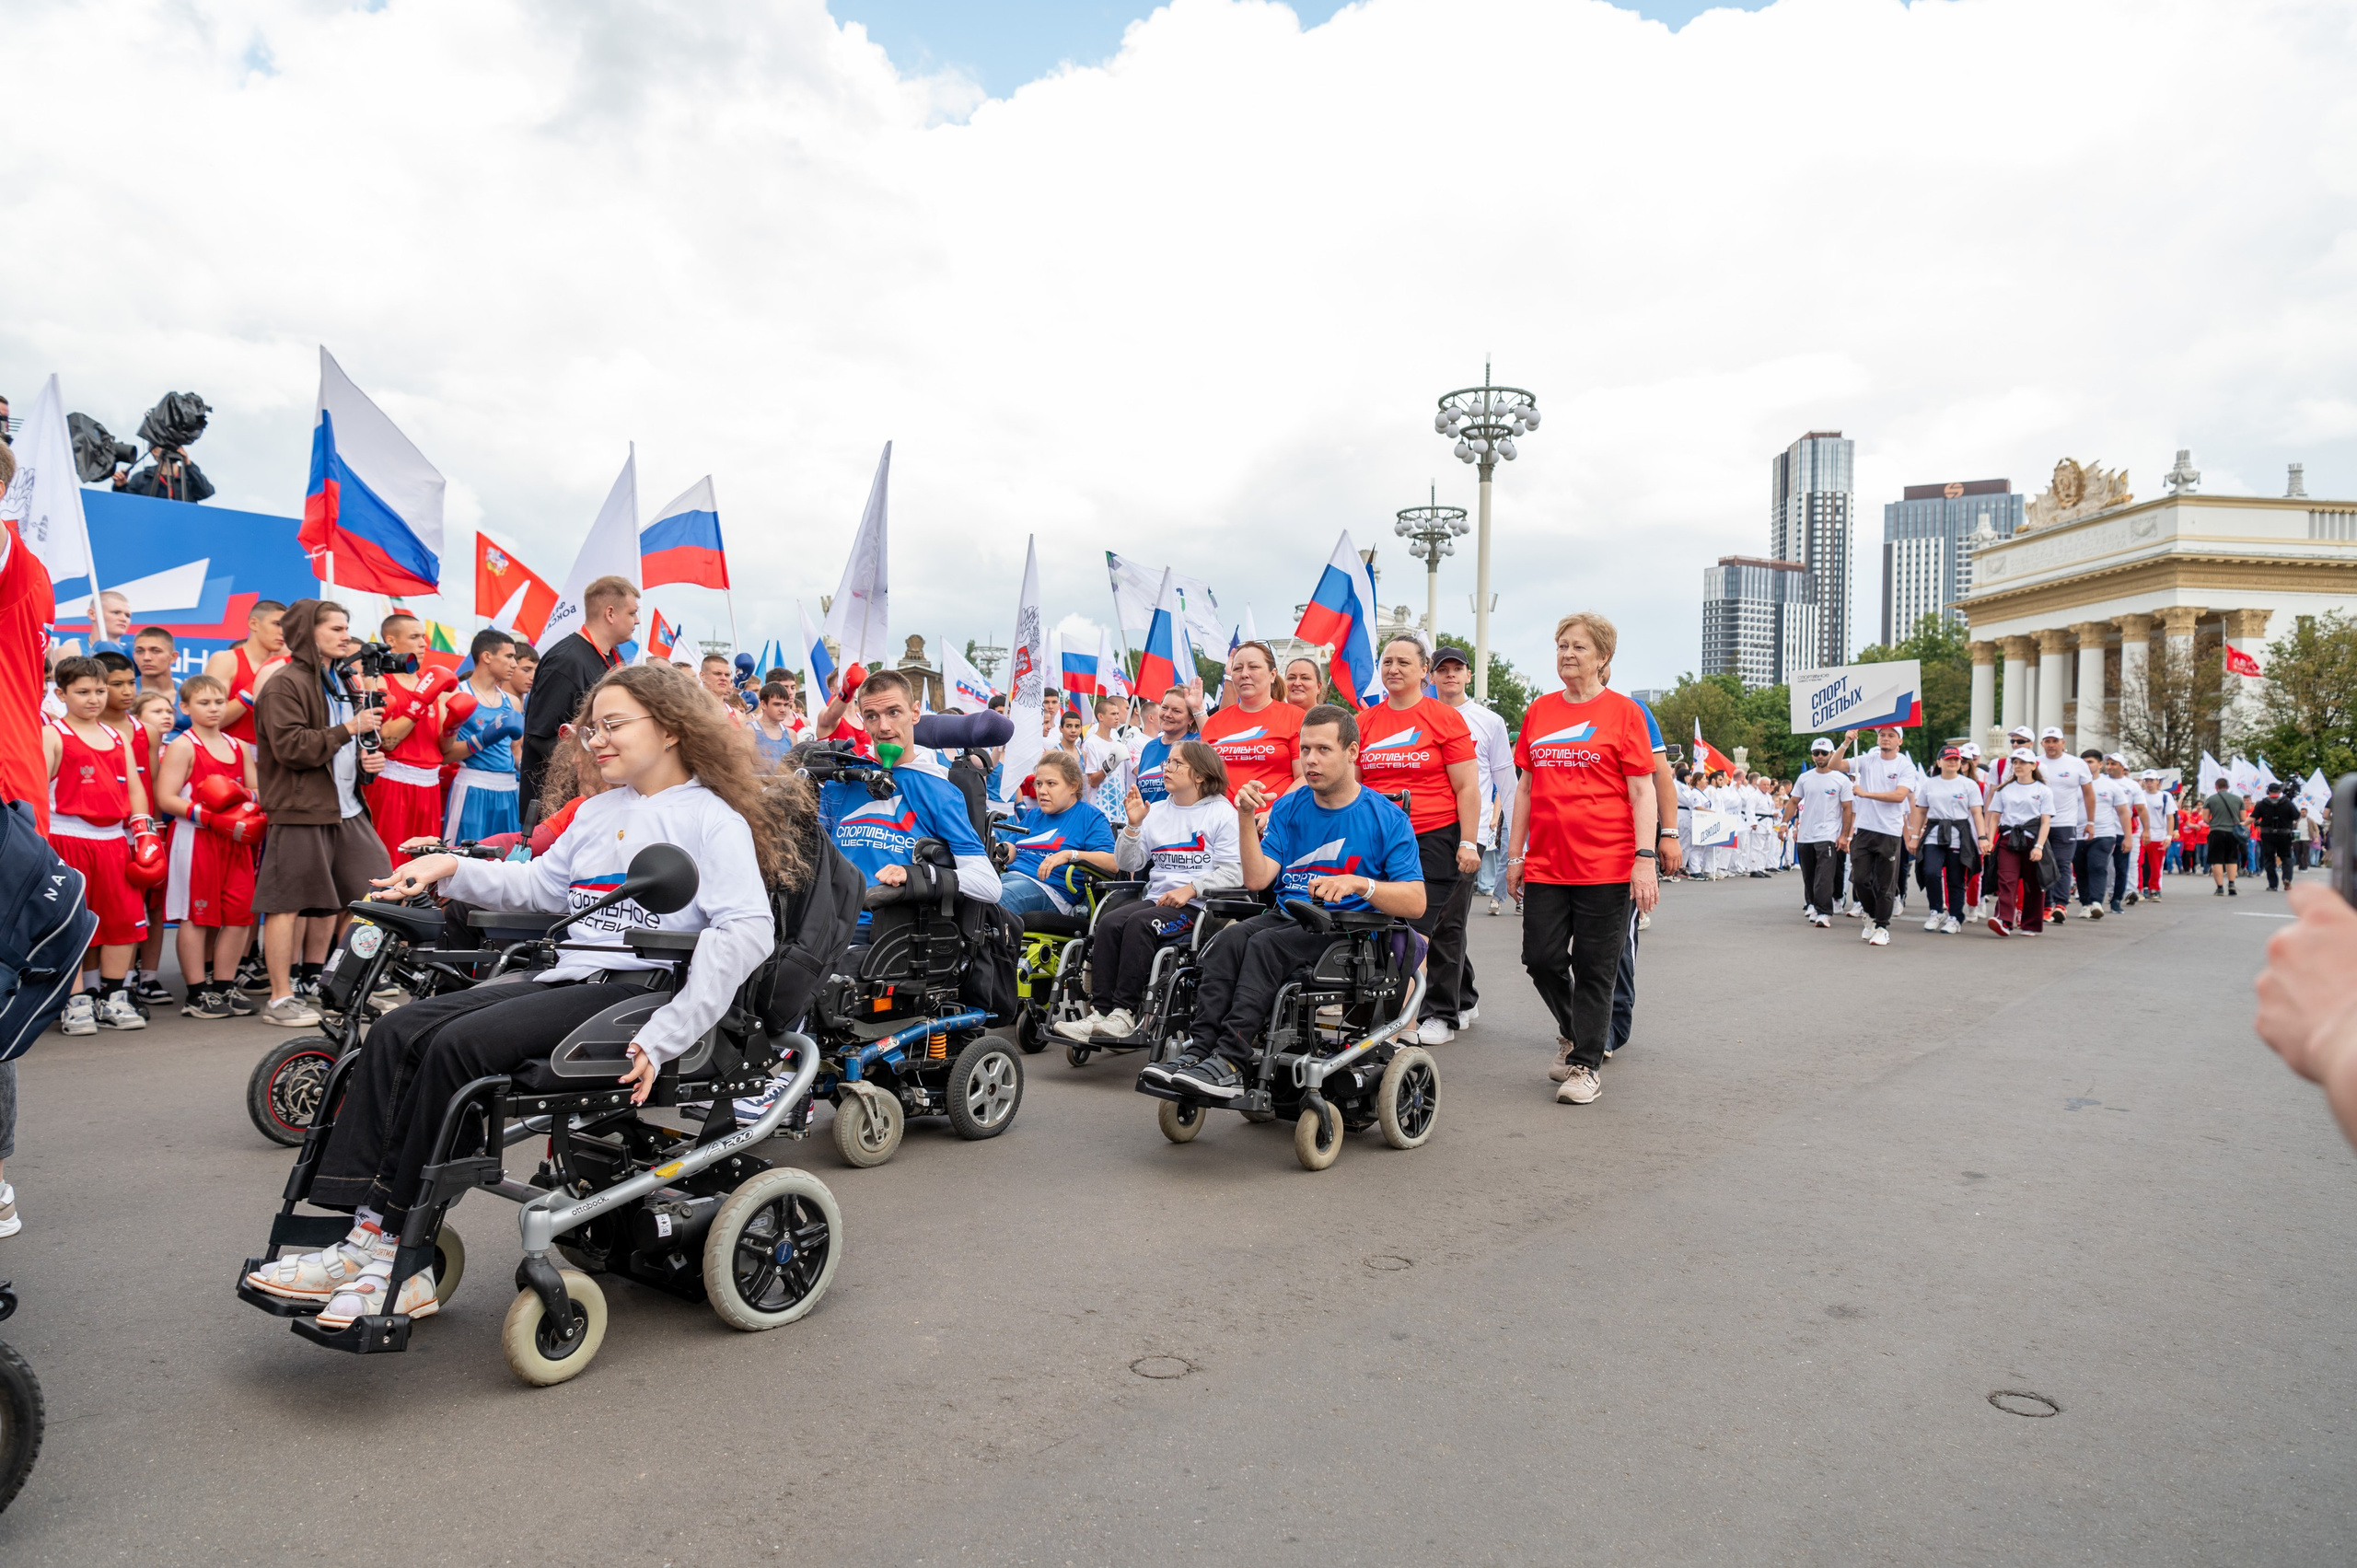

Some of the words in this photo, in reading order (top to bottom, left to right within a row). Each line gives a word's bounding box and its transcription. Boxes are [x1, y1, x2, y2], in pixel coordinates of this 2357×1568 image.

[1811, 675, 1849, 710] СПОРТ
[1812, 685, 1863, 728] СЛЕПЫХ
[1534, 760, 1589, 768] ШЕСТВИЕ
[1700, 821, 1721, 844] ДЗЮДО
[841, 839, 904, 854] ШЕСТВИЕ
